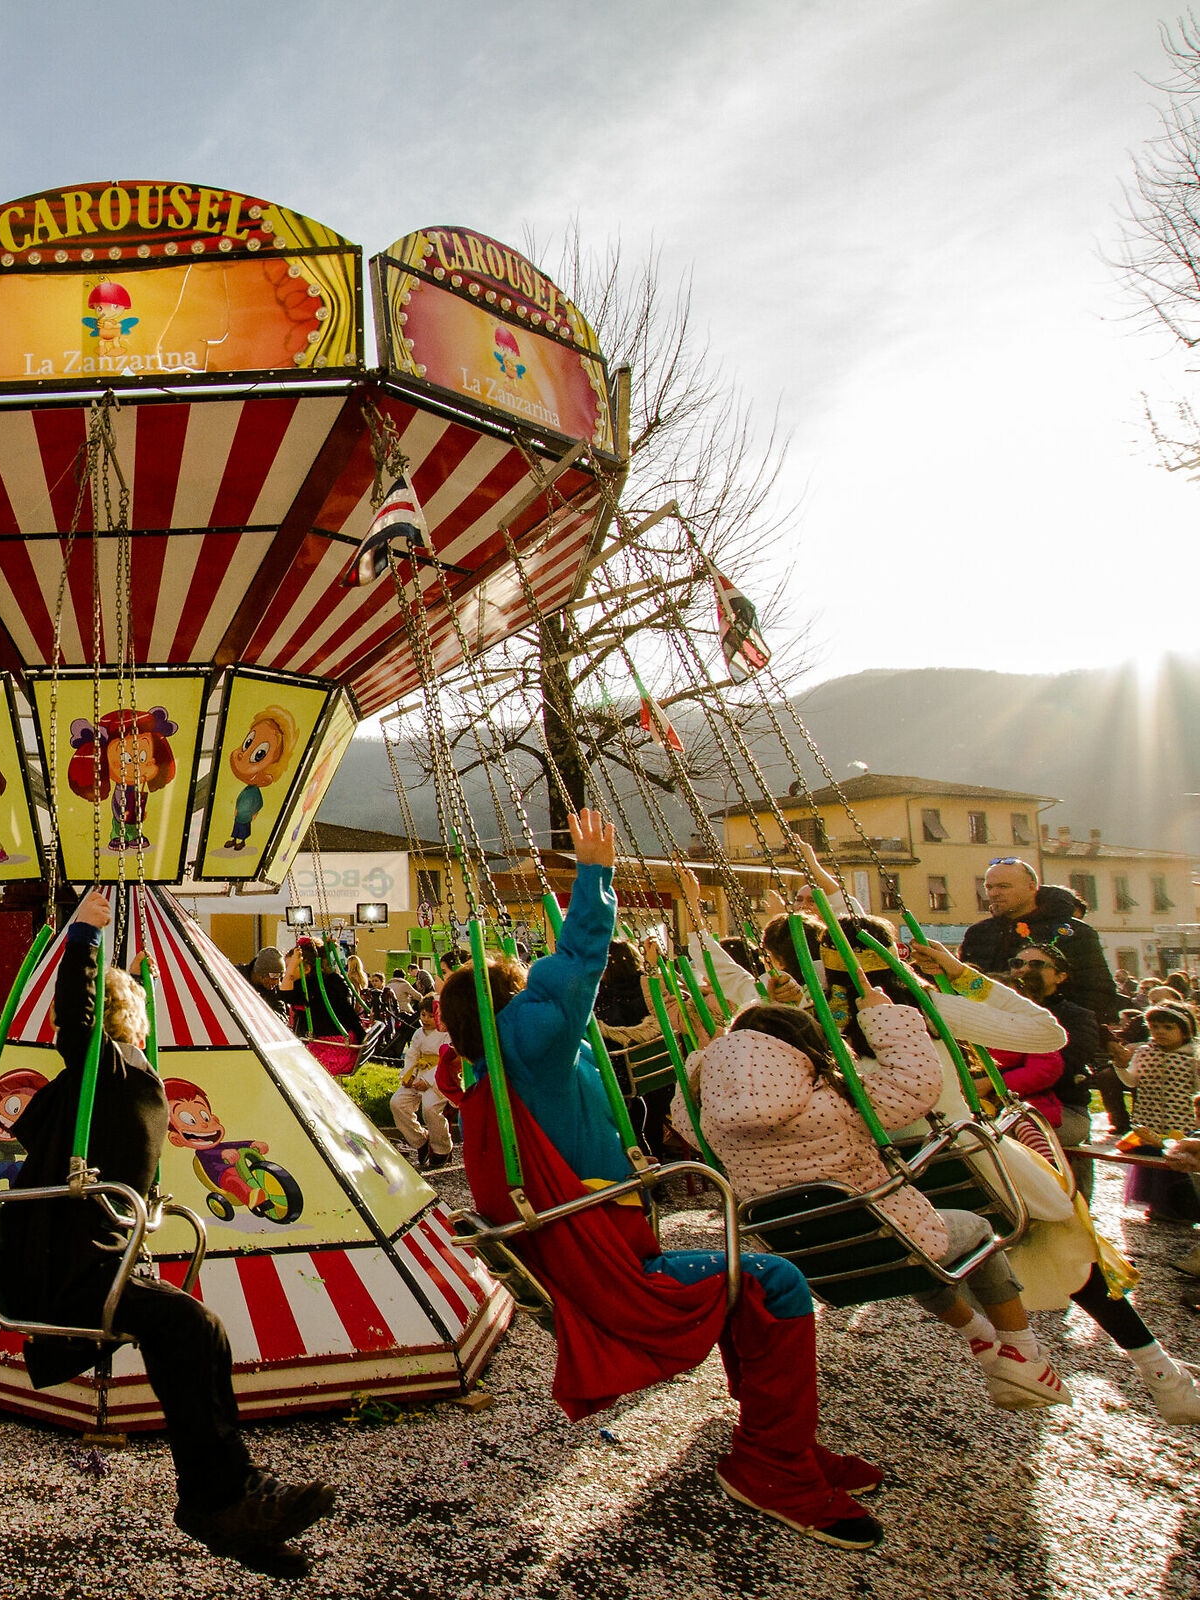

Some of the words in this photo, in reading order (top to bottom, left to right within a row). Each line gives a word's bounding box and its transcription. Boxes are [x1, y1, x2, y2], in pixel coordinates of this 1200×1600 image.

[432, 230, 562, 324] CAROUSEL
[23, 353, 54, 376] La
[63, 346, 198, 375] Zanzarina
[461, 367, 482, 394] La
[485, 377, 561, 429] Zanzarina
